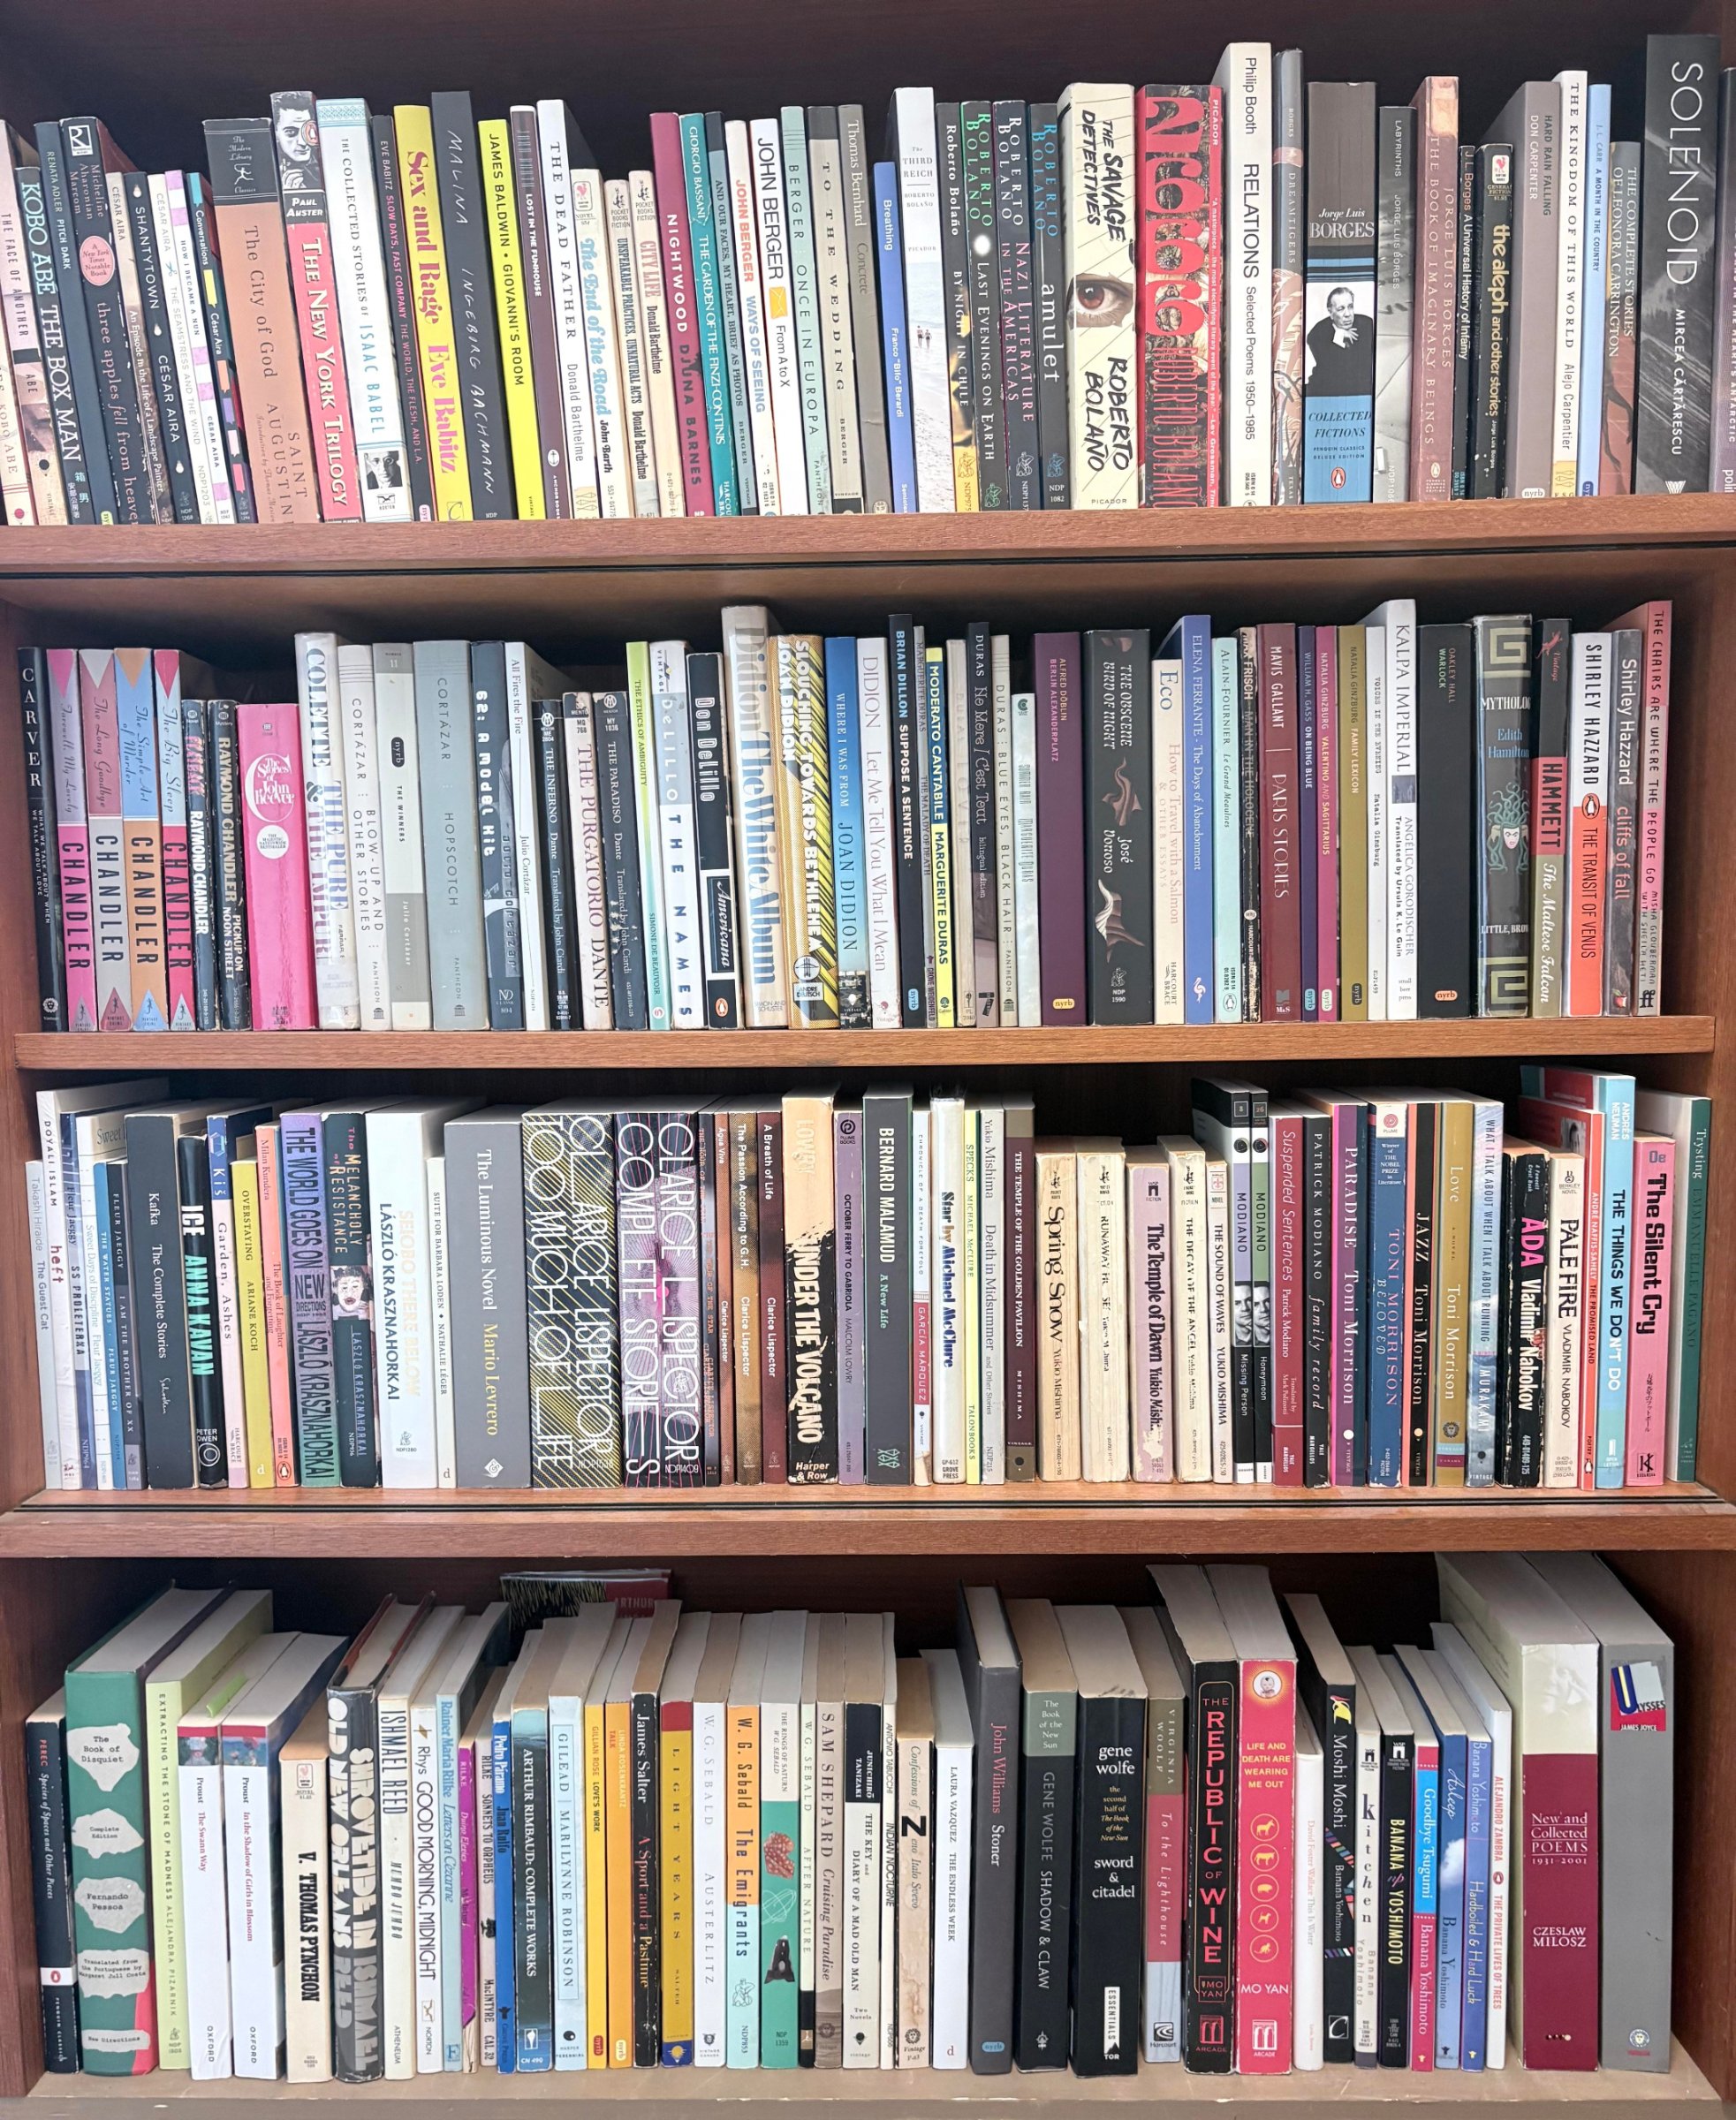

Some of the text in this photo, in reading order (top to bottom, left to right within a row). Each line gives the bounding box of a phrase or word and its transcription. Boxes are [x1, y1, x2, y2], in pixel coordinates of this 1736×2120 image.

[1244, 57, 1257, 94] Philip
[1244, 97, 1256, 134] Booth
[489, 133, 504, 183] JAMES
[1080, 110, 1101, 225] DETECTIVES
[1102, 120, 1126, 242] THE SAVAGE
[1666, 63, 1703, 285] SOLENOID
[286, 208, 323, 218] AUSTER
[292, 198, 317, 207] PAUL
[494, 186, 511, 247] BALDWIN
[757, 138, 783, 279] JOHN BERGER
[883, 200, 893, 250] Breathing
[1242, 163, 1260, 277] RELATIONS
[1318, 208, 1366, 219] Jorge Luis
[1310, 222, 1375, 238] BORGES
[21, 182, 80, 463] KOBO ABE THE BOX MAN
[135, 207, 179, 442] SHANTYTOWN CÉSAR AIRA
[1041, 283, 1065, 382] amulet
[1246, 286, 1256, 333] Selected
[1674, 308, 1686, 363] MIRCEA
[300, 238, 348, 506] THE NEW YORK TRILOGY
[511, 345, 525, 386] ROOM
[1245, 337, 1255, 375] Poems
[1523, 488, 1544, 498] nyrb
[22, 668, 42, 787] CARVER
[695, 697, 715, 733] Don
[1497, 728, 1523, 741] Edith
[1584, 645, 1602, 785] SHIRLEY HAZZARD
[896, 631, 913, 859] BRIAN DILLON SUPPOSE A SENTENCE
[1488, 745, 1529, 758] Hamilton
[929, 665, 949, 965] MODERATO CANTABILE MARGUERITE DURAS
[1541, 763, 1562, 848] HAMMETT
[62, 842, 90, 970] CHANDLER
[163, 842, 191, 970] CHANDLER
[1581, 827, 1597, 958] THE TRANSIT OF VENUS
[717, 882, 730, 968] Americana
[1540, 863, 1557, 1003] The Maltese Falcon
[1055, 999, 1073, 1008] nyrb
[1437, 991, 1456, 1000] nyrb
[213, 1168, 226, 1196] Kiš
[879, 1128, 894, 1191] BERNARD
[1649, 1150, 1666, 1163] Oe
[880, 1197, 895, 1263] MALAMUD
[1238, 1192, 1247, 1253] MODIANO
[1256, 1192, 1266, 1252] MODIANO
[1612, 1189, 1626, 1219] THE
[148, 1192, 167, 1359] Kafka The Complete Stories
[1046, 1207, 1065, 1343] Spring Snow
[1558, 1219, 1579, 1318] PALE FIRE
[1611, 1225, 1625, 1279] THINGS
[1636, 1173, 1667, 1335] The Silent Cry
[181, 1206, 215, 1376] ICE ANNA KAVAN
[295, 1274, 324, 1299] NEW
[296, 1301, 326, 1312] DIRECTIONS
[477, 1150, 498, 1435] The Luminous Novel Mario Levrero
[1611, 1285, 1623, 1308] WE
[1518, 1217, 1544, 1411] ADA Vladimir Nabokov
[1608, 1366, 1621, 1391] DO
[796, 1462, 830, 1472] Harper
[797, 1472, 805, 1480] &
[81, 1755, 124, 1764] Disquiet
[636, 1715, 651, 1803] James Salter
[1096, 1761, 1135, 1775] wolfe
[1099, 1744, 1132, 1758] gene
[1203, 1711, 1224, 1865] REPUBLIC
[1333, 1735, 1347, 1828] Moshi Moshi
[1531, 1827, 1588, 1838] Collected
[1532, 1812, 1588, 1824] New and
[1094, 1856, 1133, 1870] sword
[1361, 1793, 1376, 1924] kitchen
[1532, 1842, 1588, 1852] POEMS
[1093, 1885, 1134, 1898] citadel
[1110, 1873, 1118, 1882] &
[1206, 1870, 1221, 1879] OF
[1388, 1819, 1406, 1965] BANANA YOSHIMOTO
[298, 1852, 319, 2002] V. THOMAS PYNCHON
[1200, 1889, 1226, 1963] WINE
[1533, 1927, 1586, 1936] CZESLAW
[1533, 1936, 1586, 1948] MILOSZ
[1108, 1989, 1117, 2040] ESSENTIALS
[1241, 1984, 1289, 1994] MO YAN
